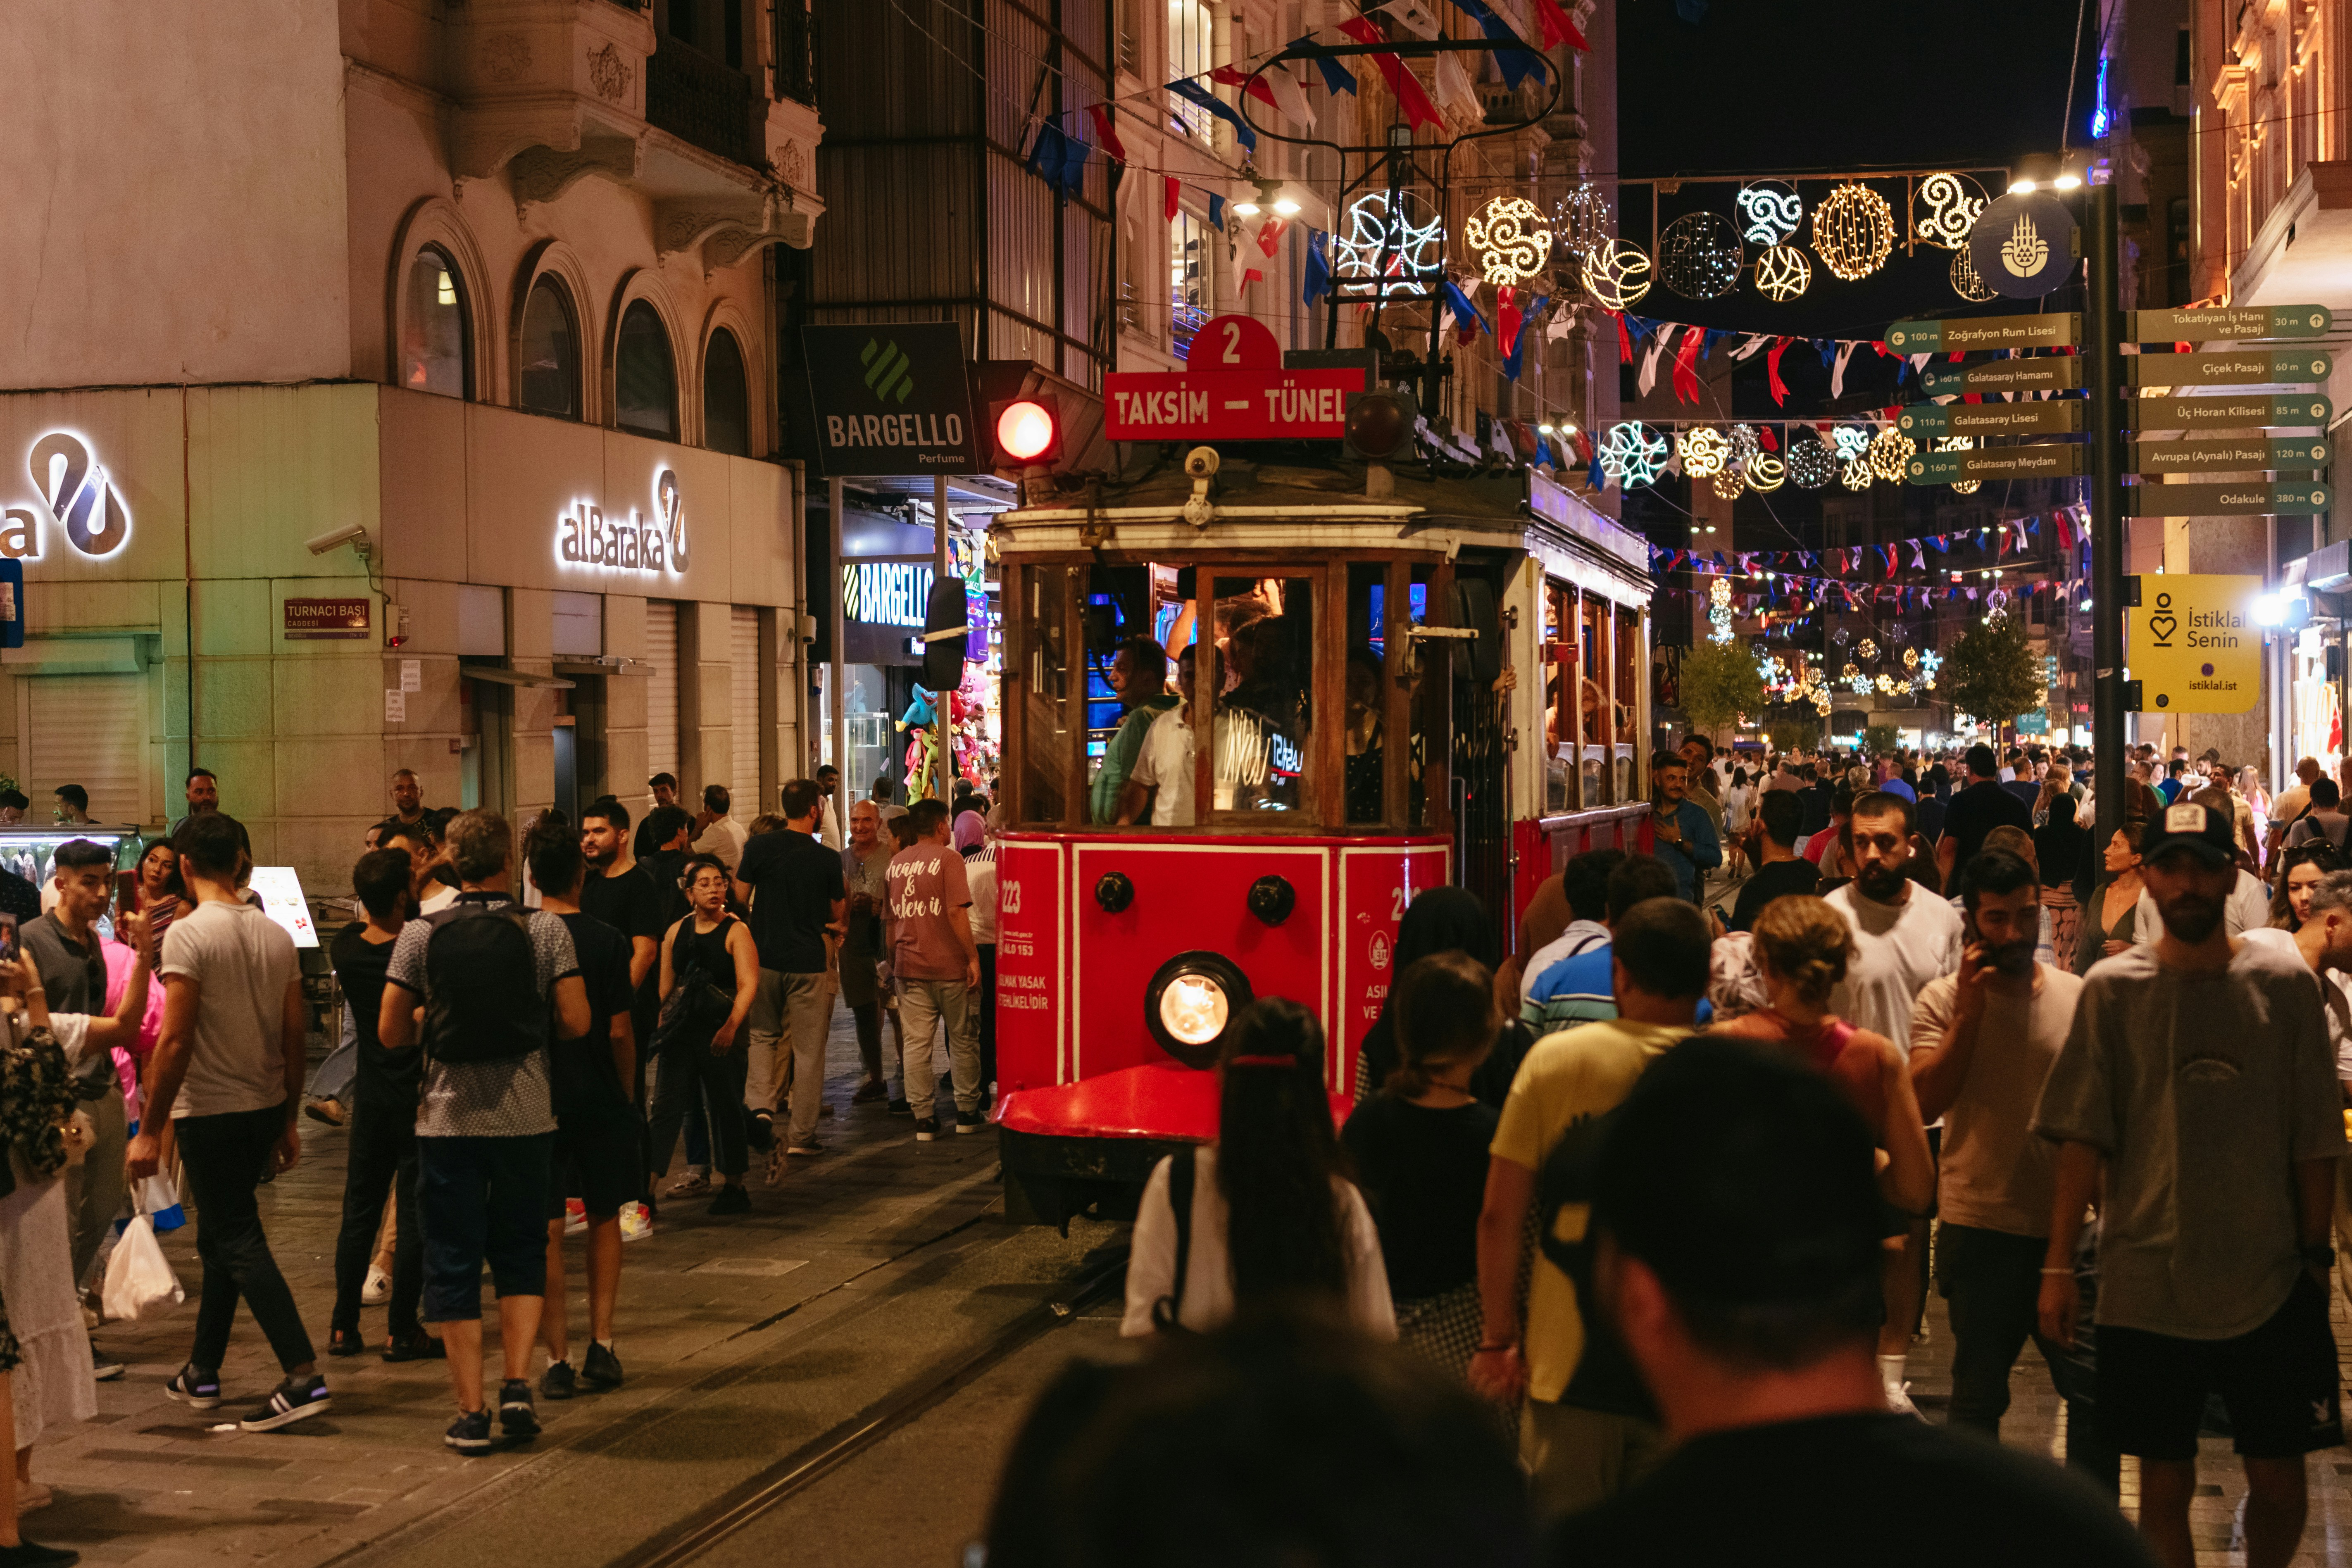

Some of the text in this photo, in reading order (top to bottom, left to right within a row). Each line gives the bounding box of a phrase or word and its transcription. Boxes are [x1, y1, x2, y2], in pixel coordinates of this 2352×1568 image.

[2173, 311, 2264, 325] Tokatlıyan İş Hanı
[2275, 318, 2287, 326] 30
[1948, 326, 2056, 342] Zoğrafyon Rum Lisesi
[2234, 325, 2264, 335] Pasajı
[1222, 322, 1240, 364] 2
[1910, 333, 1927, 341] 100
[2202, 363, 2264, 375] Çiçek Pasajı
[1968, 371, 2053, 384] Galatasaray Hamamı
[1114, 381, 1209, 425] TAKSİM
[1264, 379, 1345, 423] TÜNEL
[2177, 406, 2265, 419] Üç Horan Kilisesi
[2276, 407, 2288, 415] 85
[1919, 418, 1935, 426] 110
[1954, 413, 2039, 426] Galatasaray Lisesi
[827, 413, 963, 447] BARGELLO
[919, 454, 965, 464] Perfume
[2152, 450, 2265, 464] Avrupa (Aynalı) Pasajı
[2276, 450, 2294, 458] 120
[1930, 463, 1947, 472] 160
[1966, 457, 2057, 470] Galatasaray Meydanı
[2219, 494, 2265, 504] Odakule
[2276, 494, 2294, 503] 380
[561, 504, 664, 571] alBaraka
[288, 605, 365, 618] TURNACI BAŞI
[2188, 607, 2247, 629] İstiklal
[2187, 631, 2239, 648] Senin
[2189, 680, 2238, 691] istiklal.ist
[928, 858, 941, 876] it
[904, 875, 915, 897] &
[1002, 880, 1021, 914] 223
[930, 897, 942, 916] it
[1017, 944, 1034, 957] 153
[1018, 975, 1046, 989] YASAK
[1363, 1006, 1378, 1019] VE
